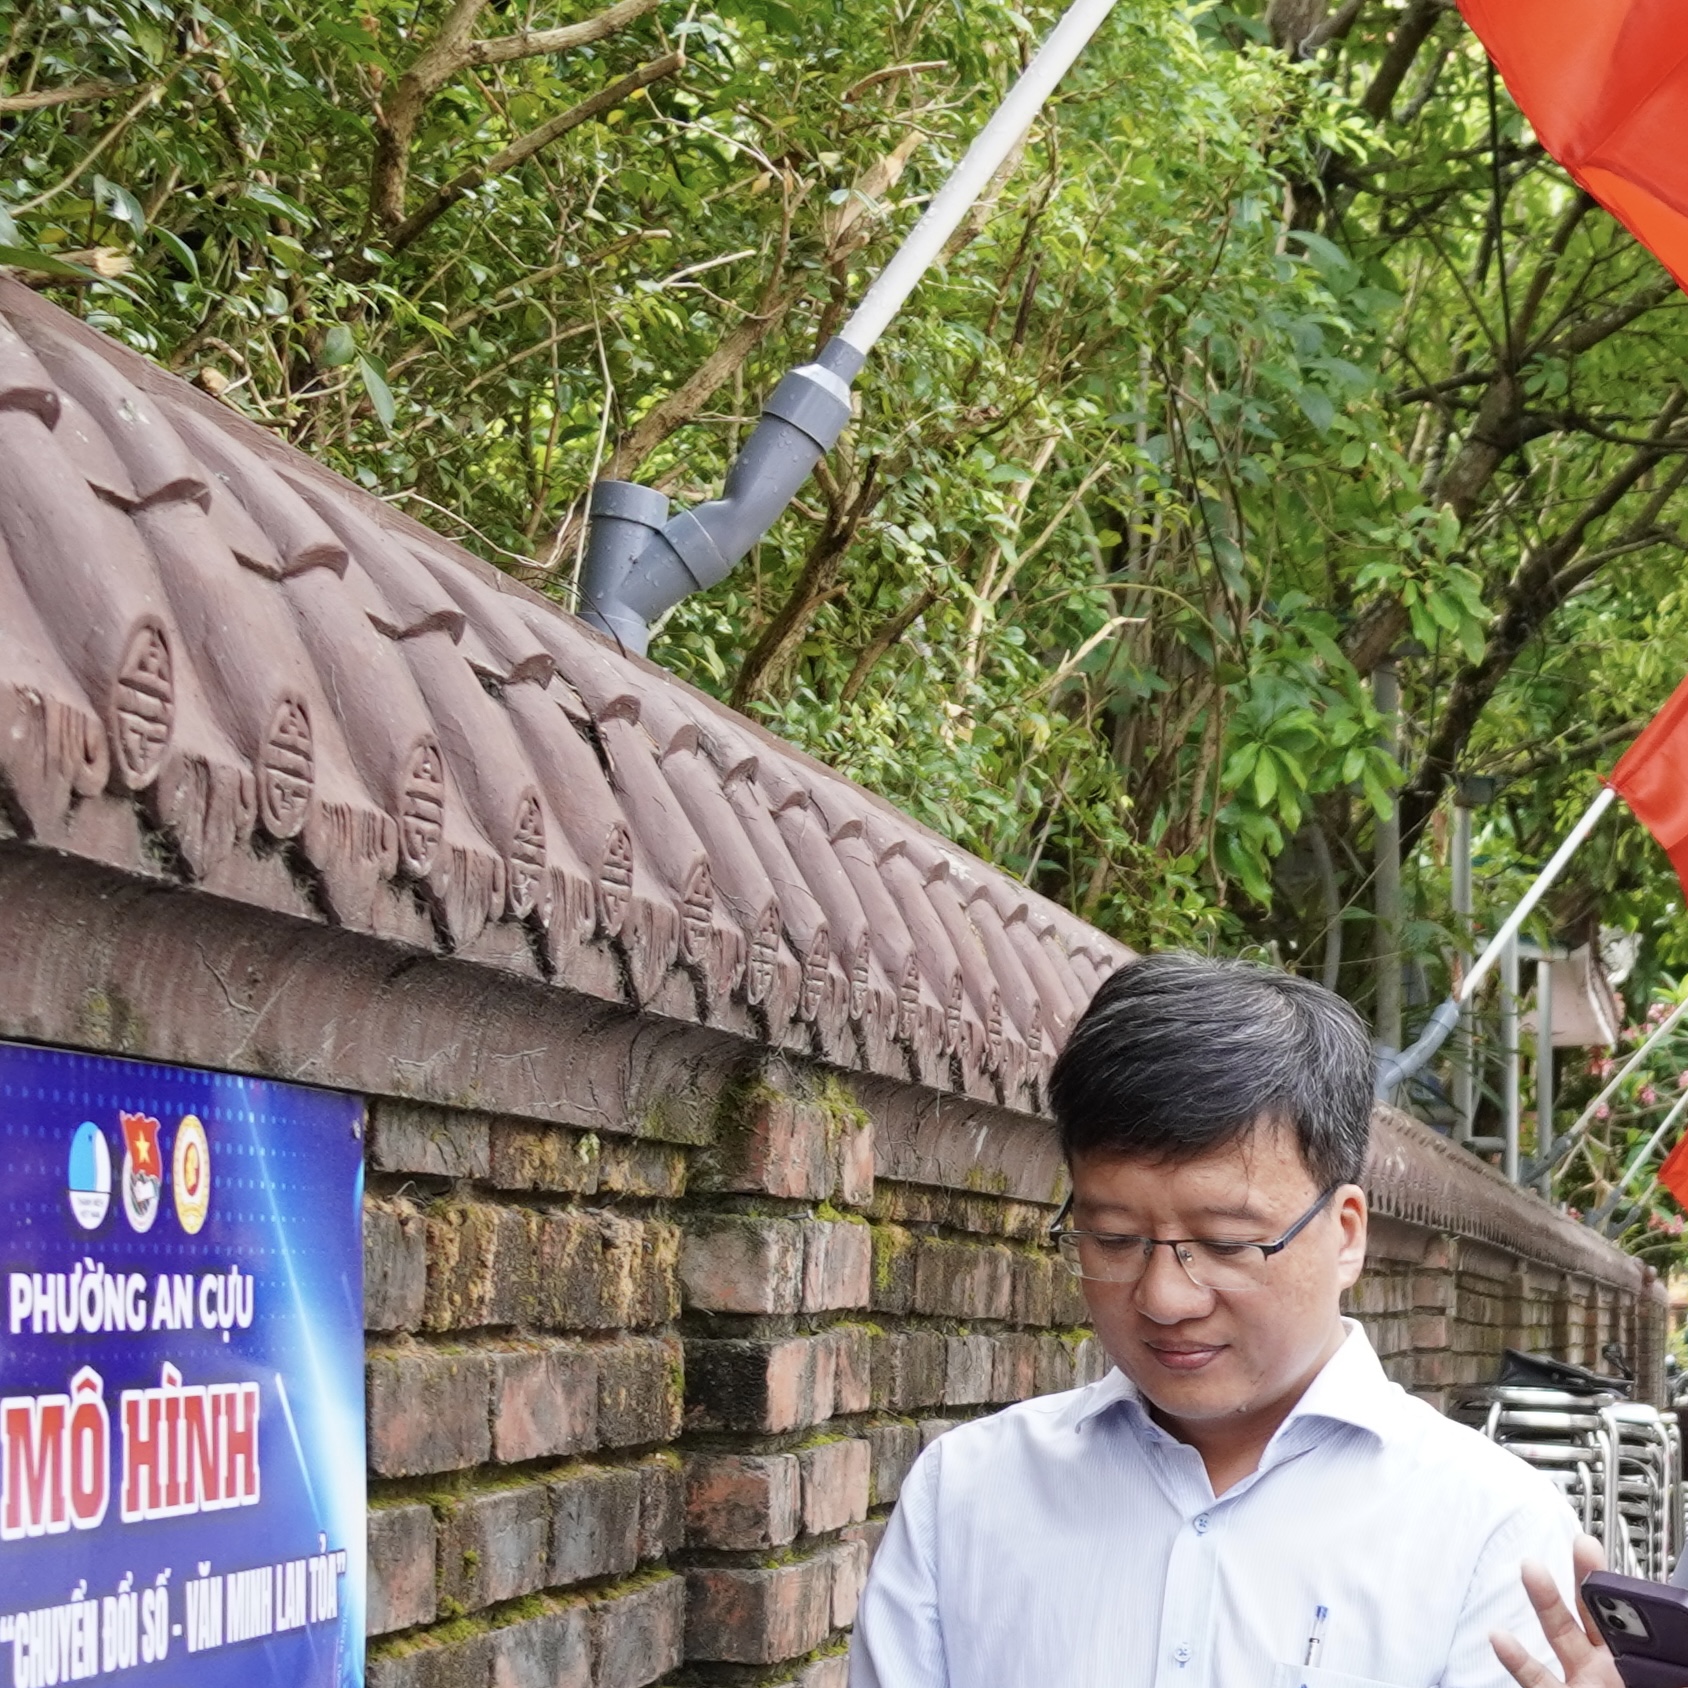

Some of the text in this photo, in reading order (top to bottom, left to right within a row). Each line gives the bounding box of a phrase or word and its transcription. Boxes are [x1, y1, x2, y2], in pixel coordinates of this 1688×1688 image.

[9, 1257, 254, 1343] PHƯỜNG AN CỰU
[1, 1361, 260, 1541] MÔ HÌNH
[102, 1570, 138, 1673] ĐỔI
[142, 1567, 172, 1664] SỐ
[186, 1560, 223, 1653] VĂN
[226, 1566, 273, 1644] MINH
[276, 1559, 307, 1632] LAN
